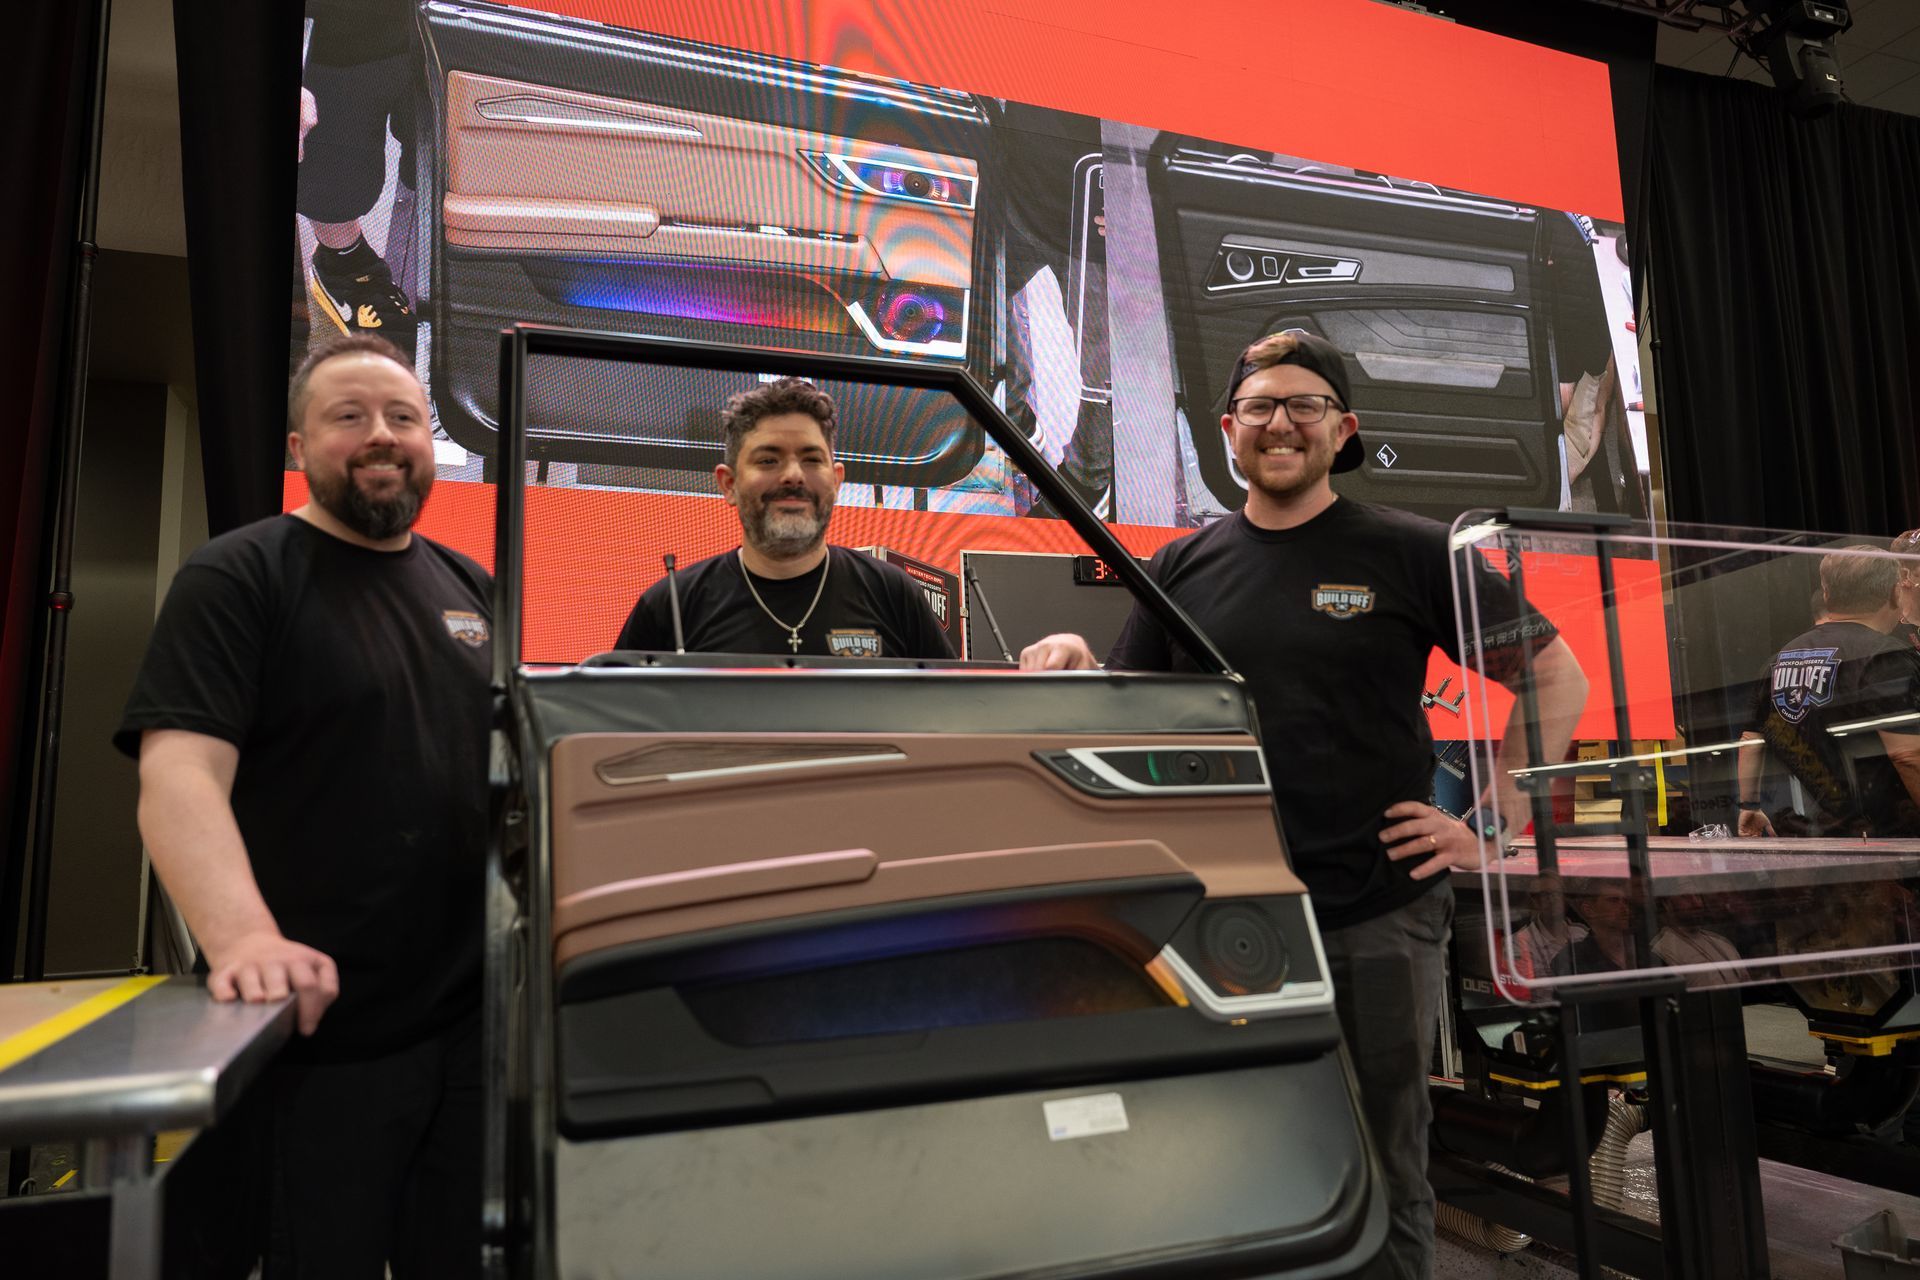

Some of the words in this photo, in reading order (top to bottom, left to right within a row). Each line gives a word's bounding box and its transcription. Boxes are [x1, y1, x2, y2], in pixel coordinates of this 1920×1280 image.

[931, 591, 947, 622] OFF
[1316, 592, 1349, 606] BUILD
[1349, 594, 1370, 609] OFF
[831, 637, 861, 652] BUILD
[861, 638, 878, 653] OFF
